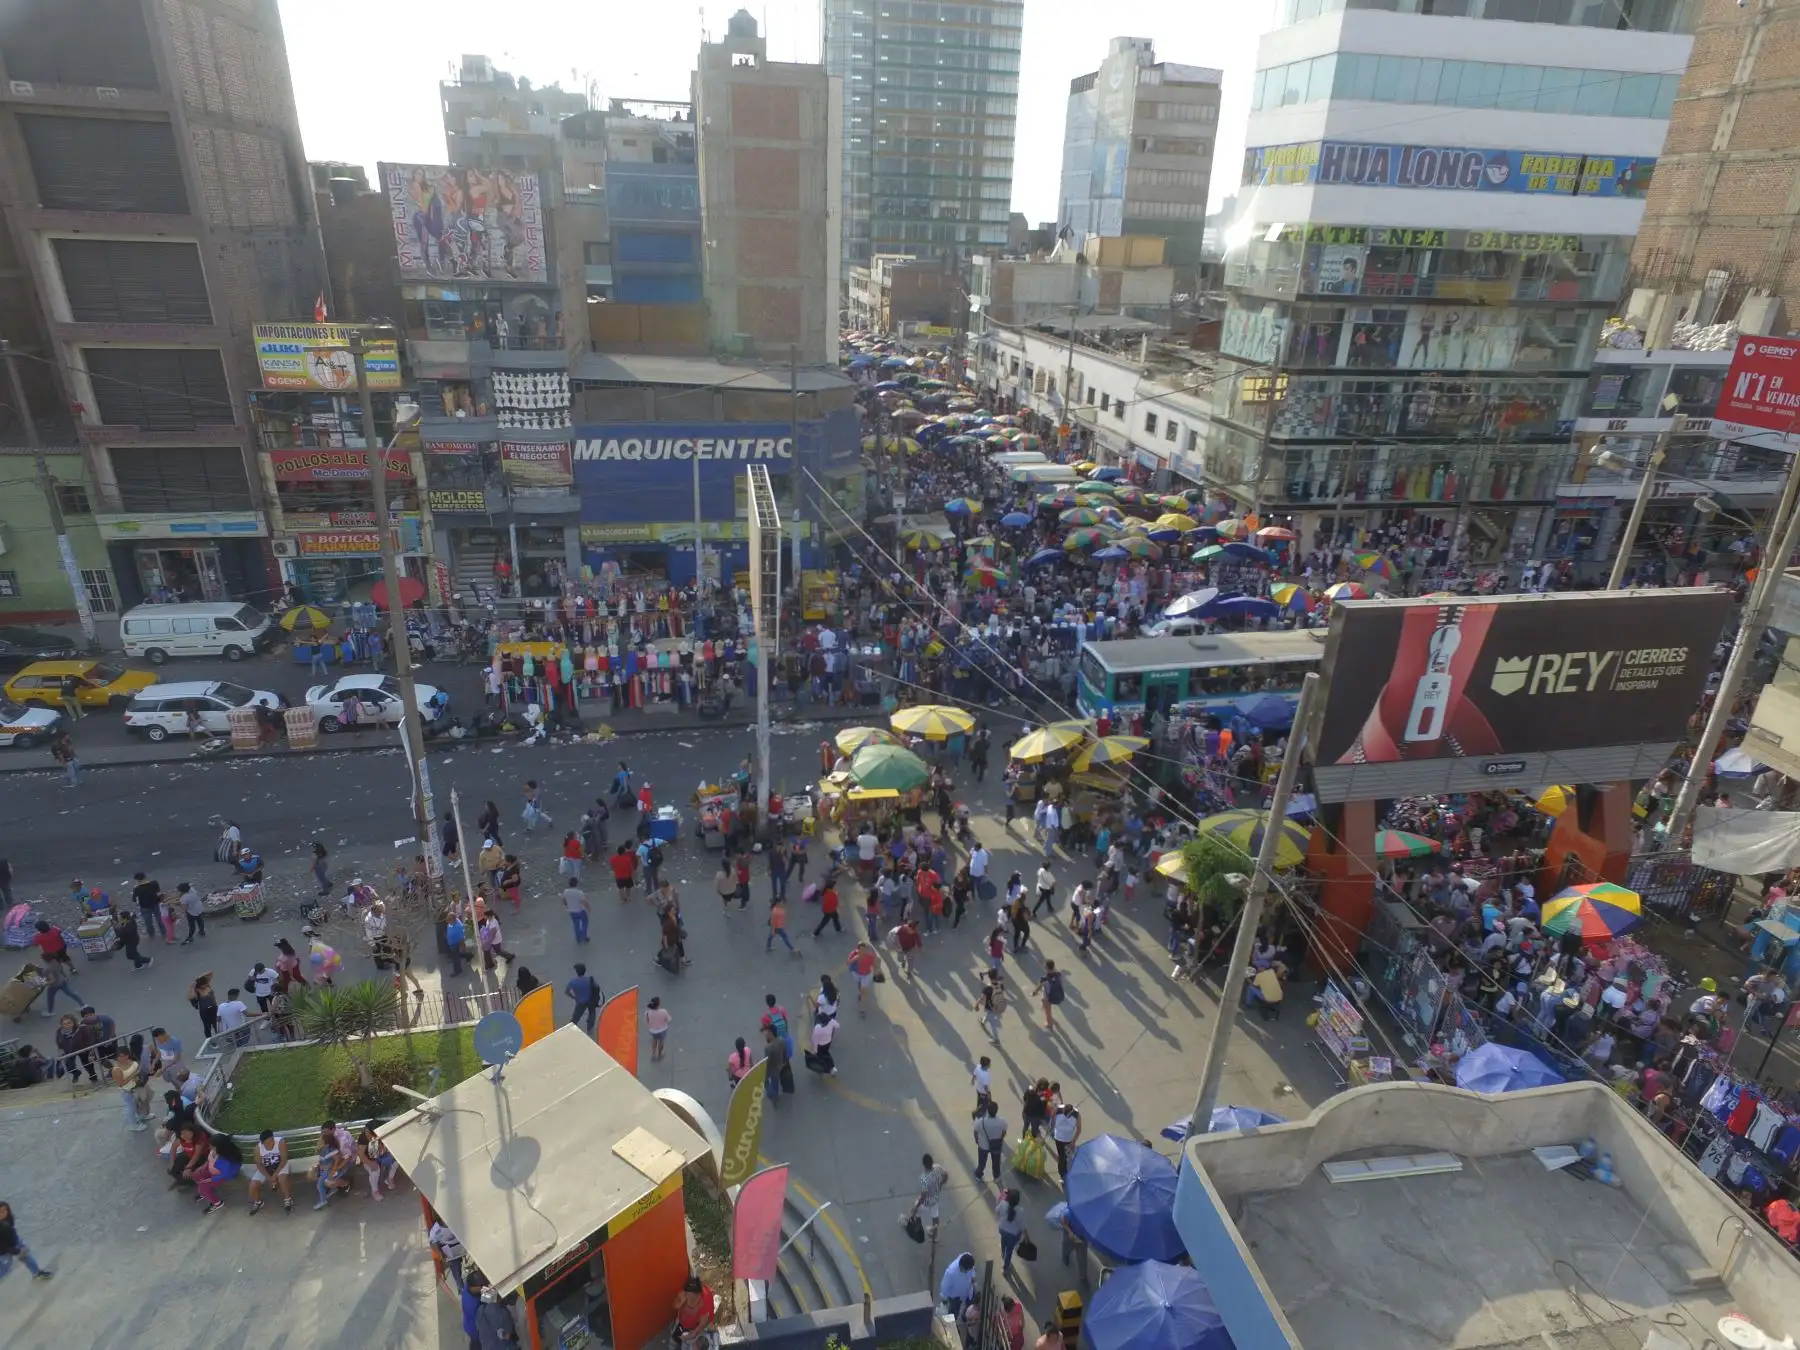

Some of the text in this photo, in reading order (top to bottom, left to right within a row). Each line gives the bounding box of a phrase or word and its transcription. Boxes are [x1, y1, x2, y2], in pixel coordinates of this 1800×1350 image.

[1321, 144, 1392, 184] HUA
[1396, 146, 1486, 189] LONG
[256, 325, 329, 339] IMPORTACIONES
[261, 343, 300, 353] JUKI
[1759, 345, 1798, 357] GEMSY
[277, 377, 308, 385] GEMSY
[1770, 376, 1784, 389] EN
[1766, 391, 1800, 408] VENTAS
[573, 439, 793, 461] MAQUICENTRO
[276, 453, 330, 476] POLLOS
[345, 452, 358, 464] la
[429, 491, 484, 504] MOLDES
[318, 534, 381, 543] BOTICAS
[1625, 647, 1689, 665] CIERRES
[1528, 651, 1614, 695] REY
[1619, 665, 1686, 678] DETALLES QUE
[1615, 680, 1659, 691] INSPIRAN
[723, 1081, 765, 1181] Canepa
[1707, 1148, 1722, 1165] 76
